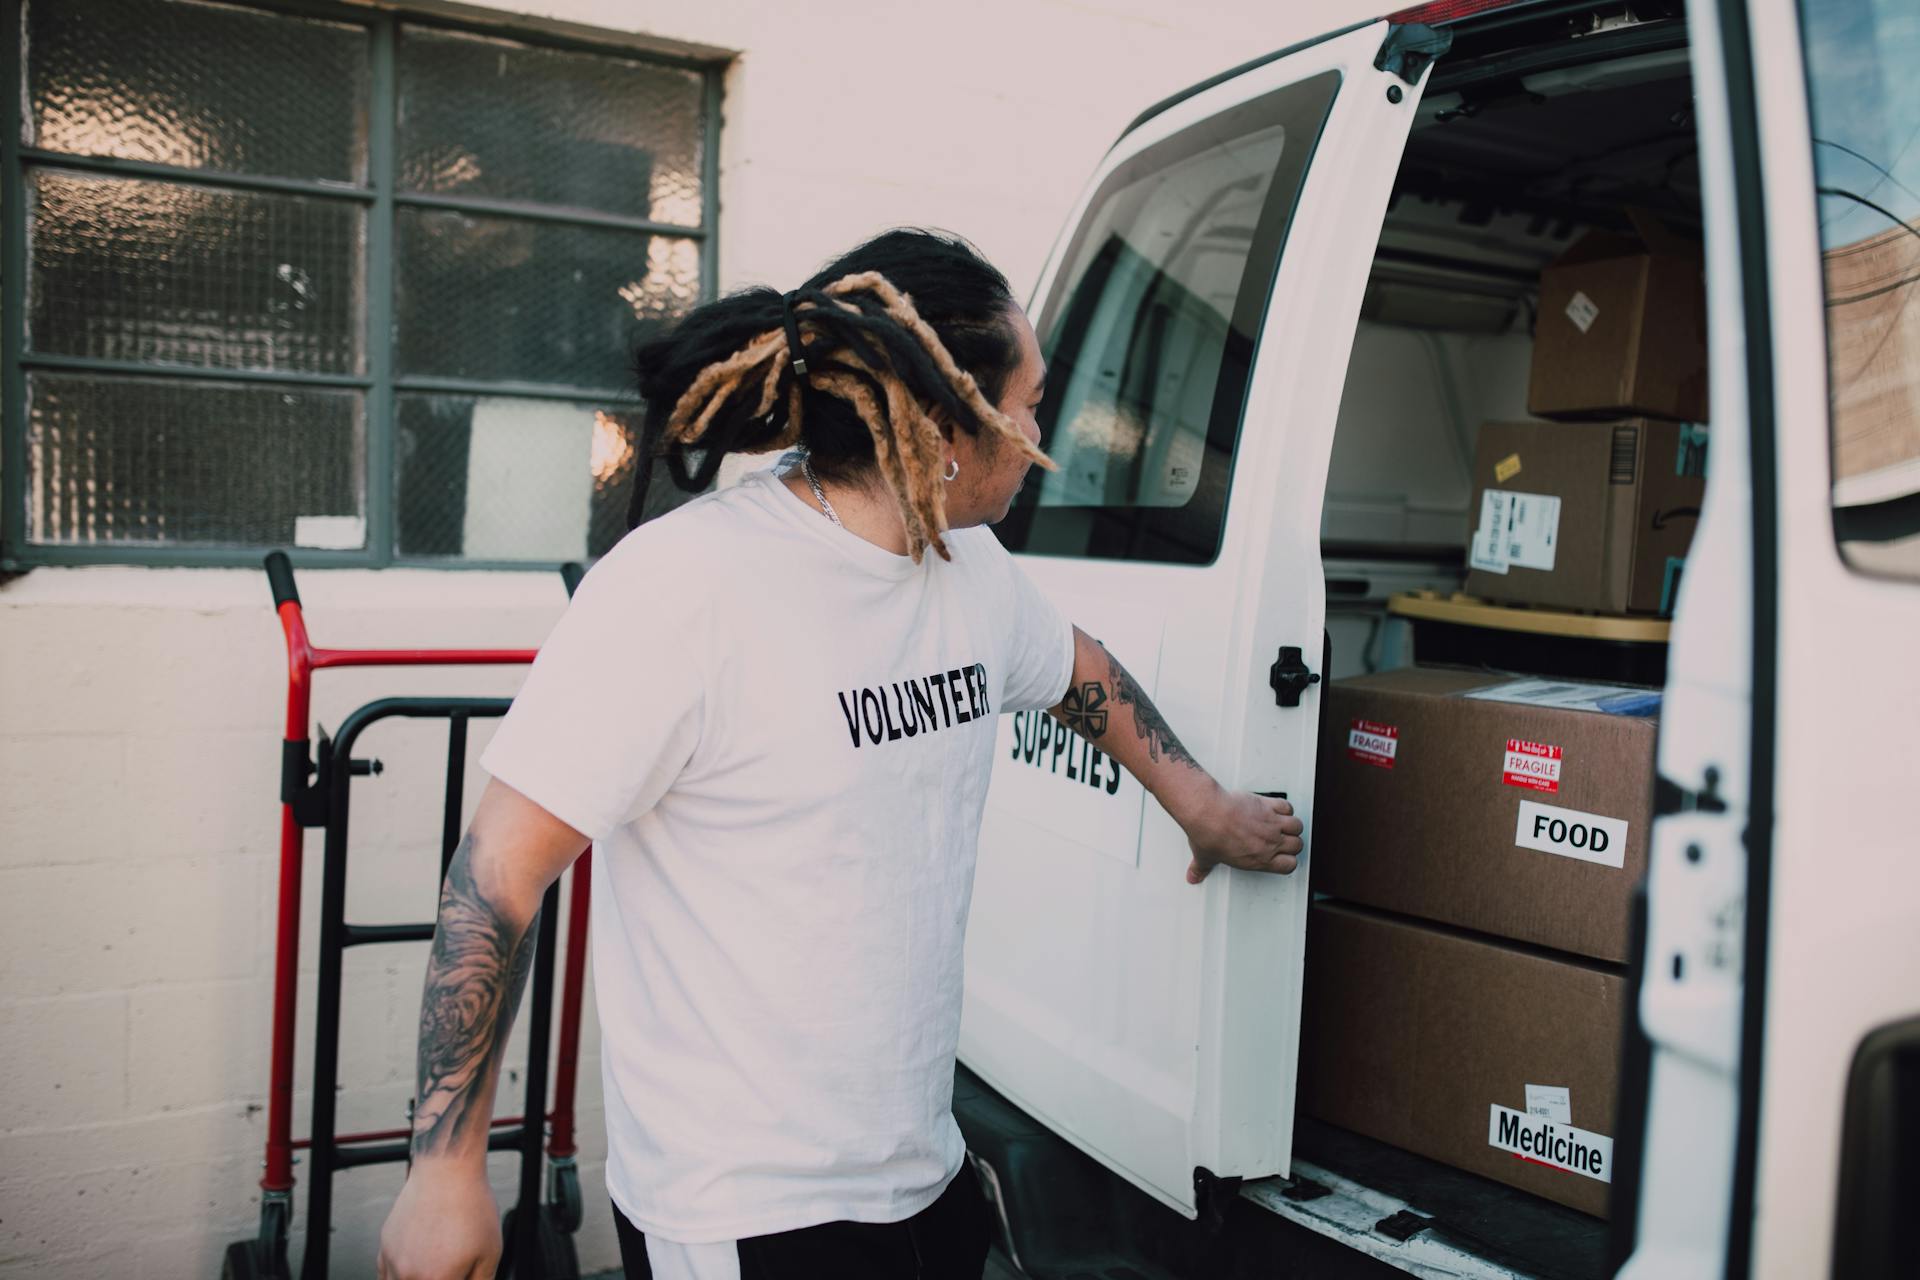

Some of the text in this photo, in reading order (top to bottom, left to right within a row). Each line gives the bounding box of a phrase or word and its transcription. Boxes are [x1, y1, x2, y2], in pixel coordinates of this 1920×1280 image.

[838, 663, 990, 748] VOLUNTEER
[1012, 711, 1120, 795] SUPPLIES
[1353, 734, 1392, 754] FRAGILE
[1509, 757, 1556, 776] FRAGILE
[1533, 814, 1609, 853] FOOD
[1498, 1111, 1602, 1175] Medicine
